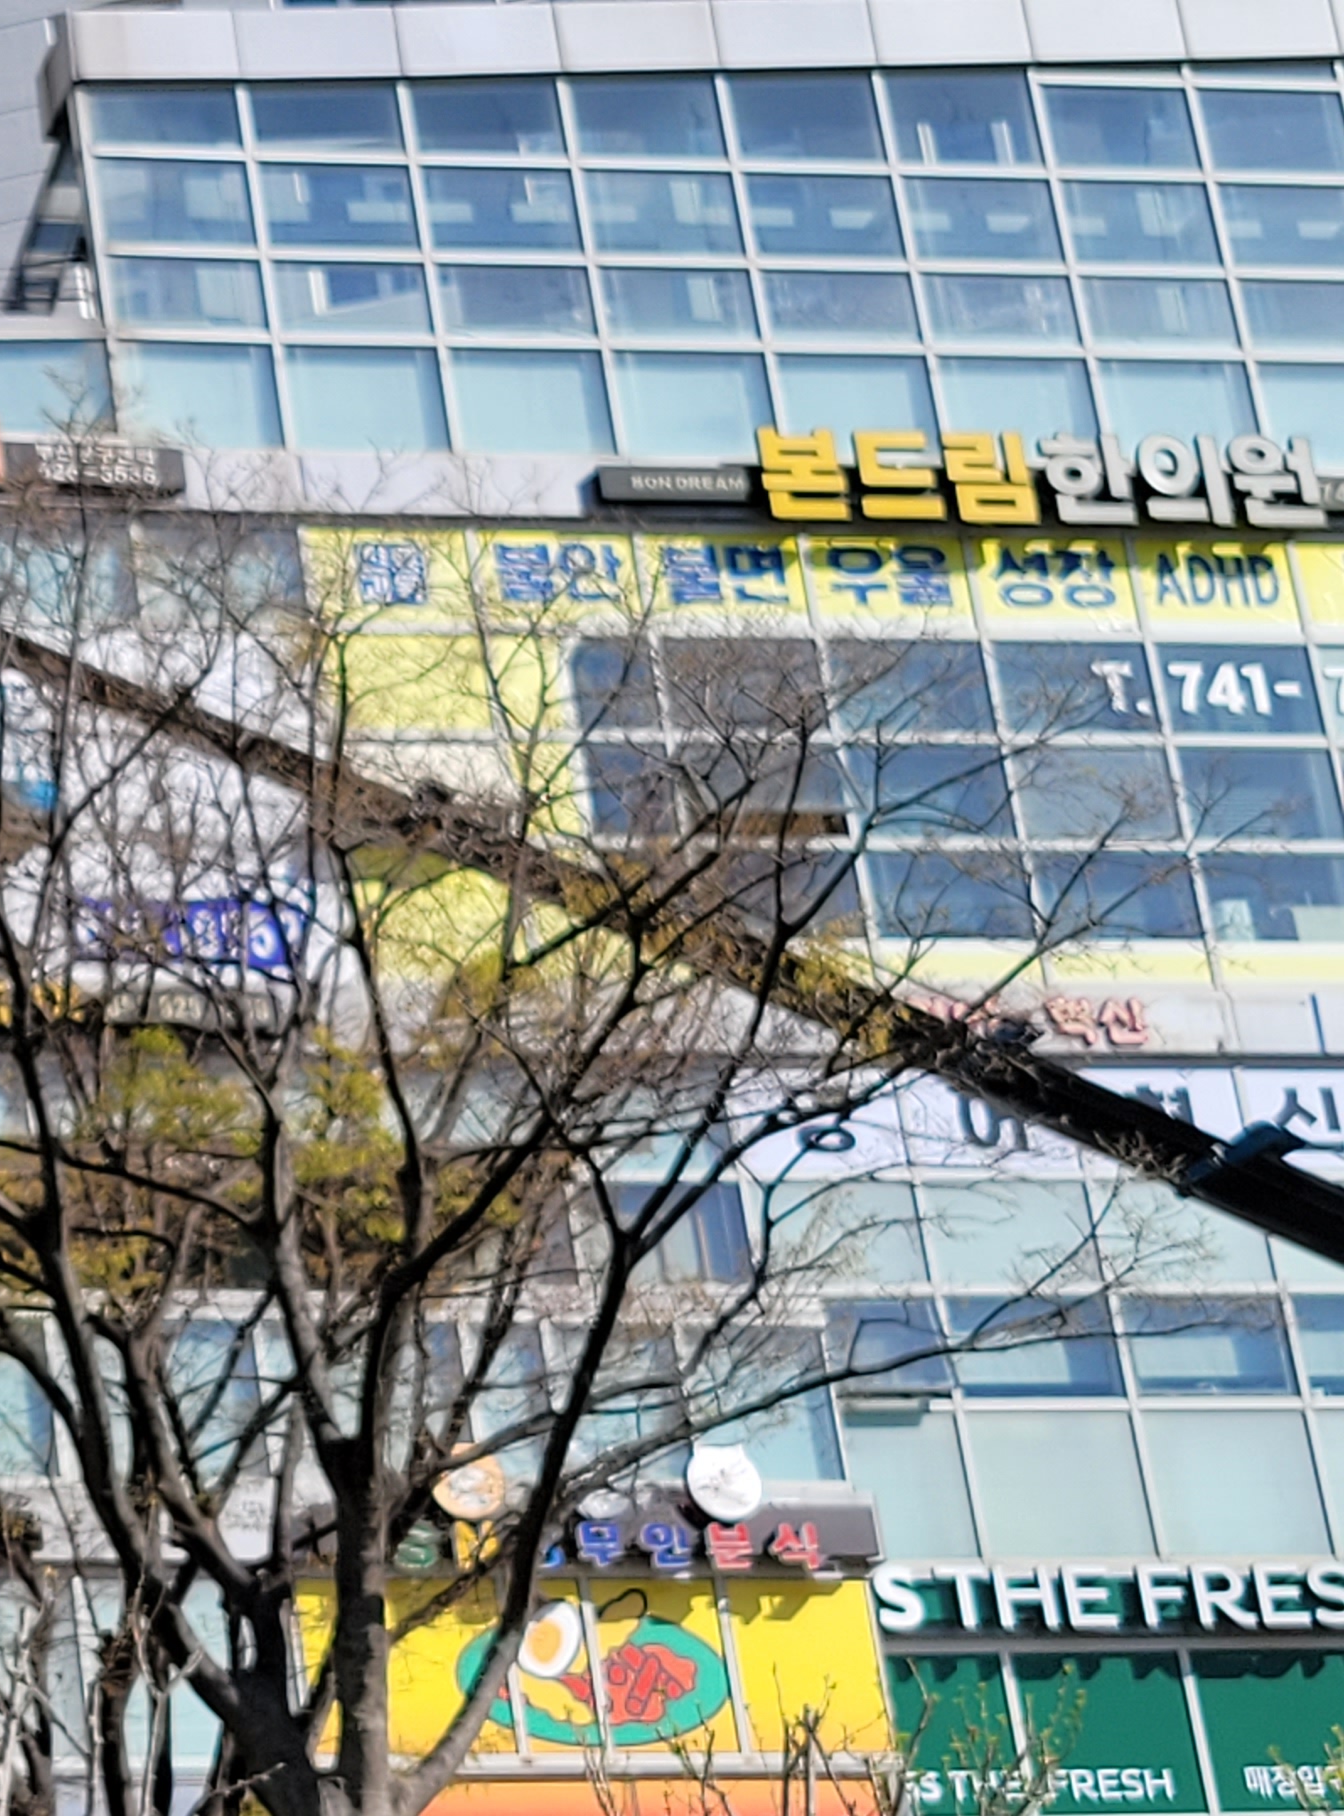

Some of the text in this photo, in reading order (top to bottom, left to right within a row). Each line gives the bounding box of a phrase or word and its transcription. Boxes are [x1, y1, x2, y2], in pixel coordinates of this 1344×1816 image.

[758, 425, 1326, 530] 본드림한의원
[492, 542, 622, 602] 불안
[664, 542, 790, 602] 불면
[825, 542, 954, 608] 우울
[994, 542, 1120, 610] 성장
[1153, 548, 1284, 610] ADHD
[933, 1563, 1120, 1632] THE
[1047, 1767, 1176, 1803] FRESH
